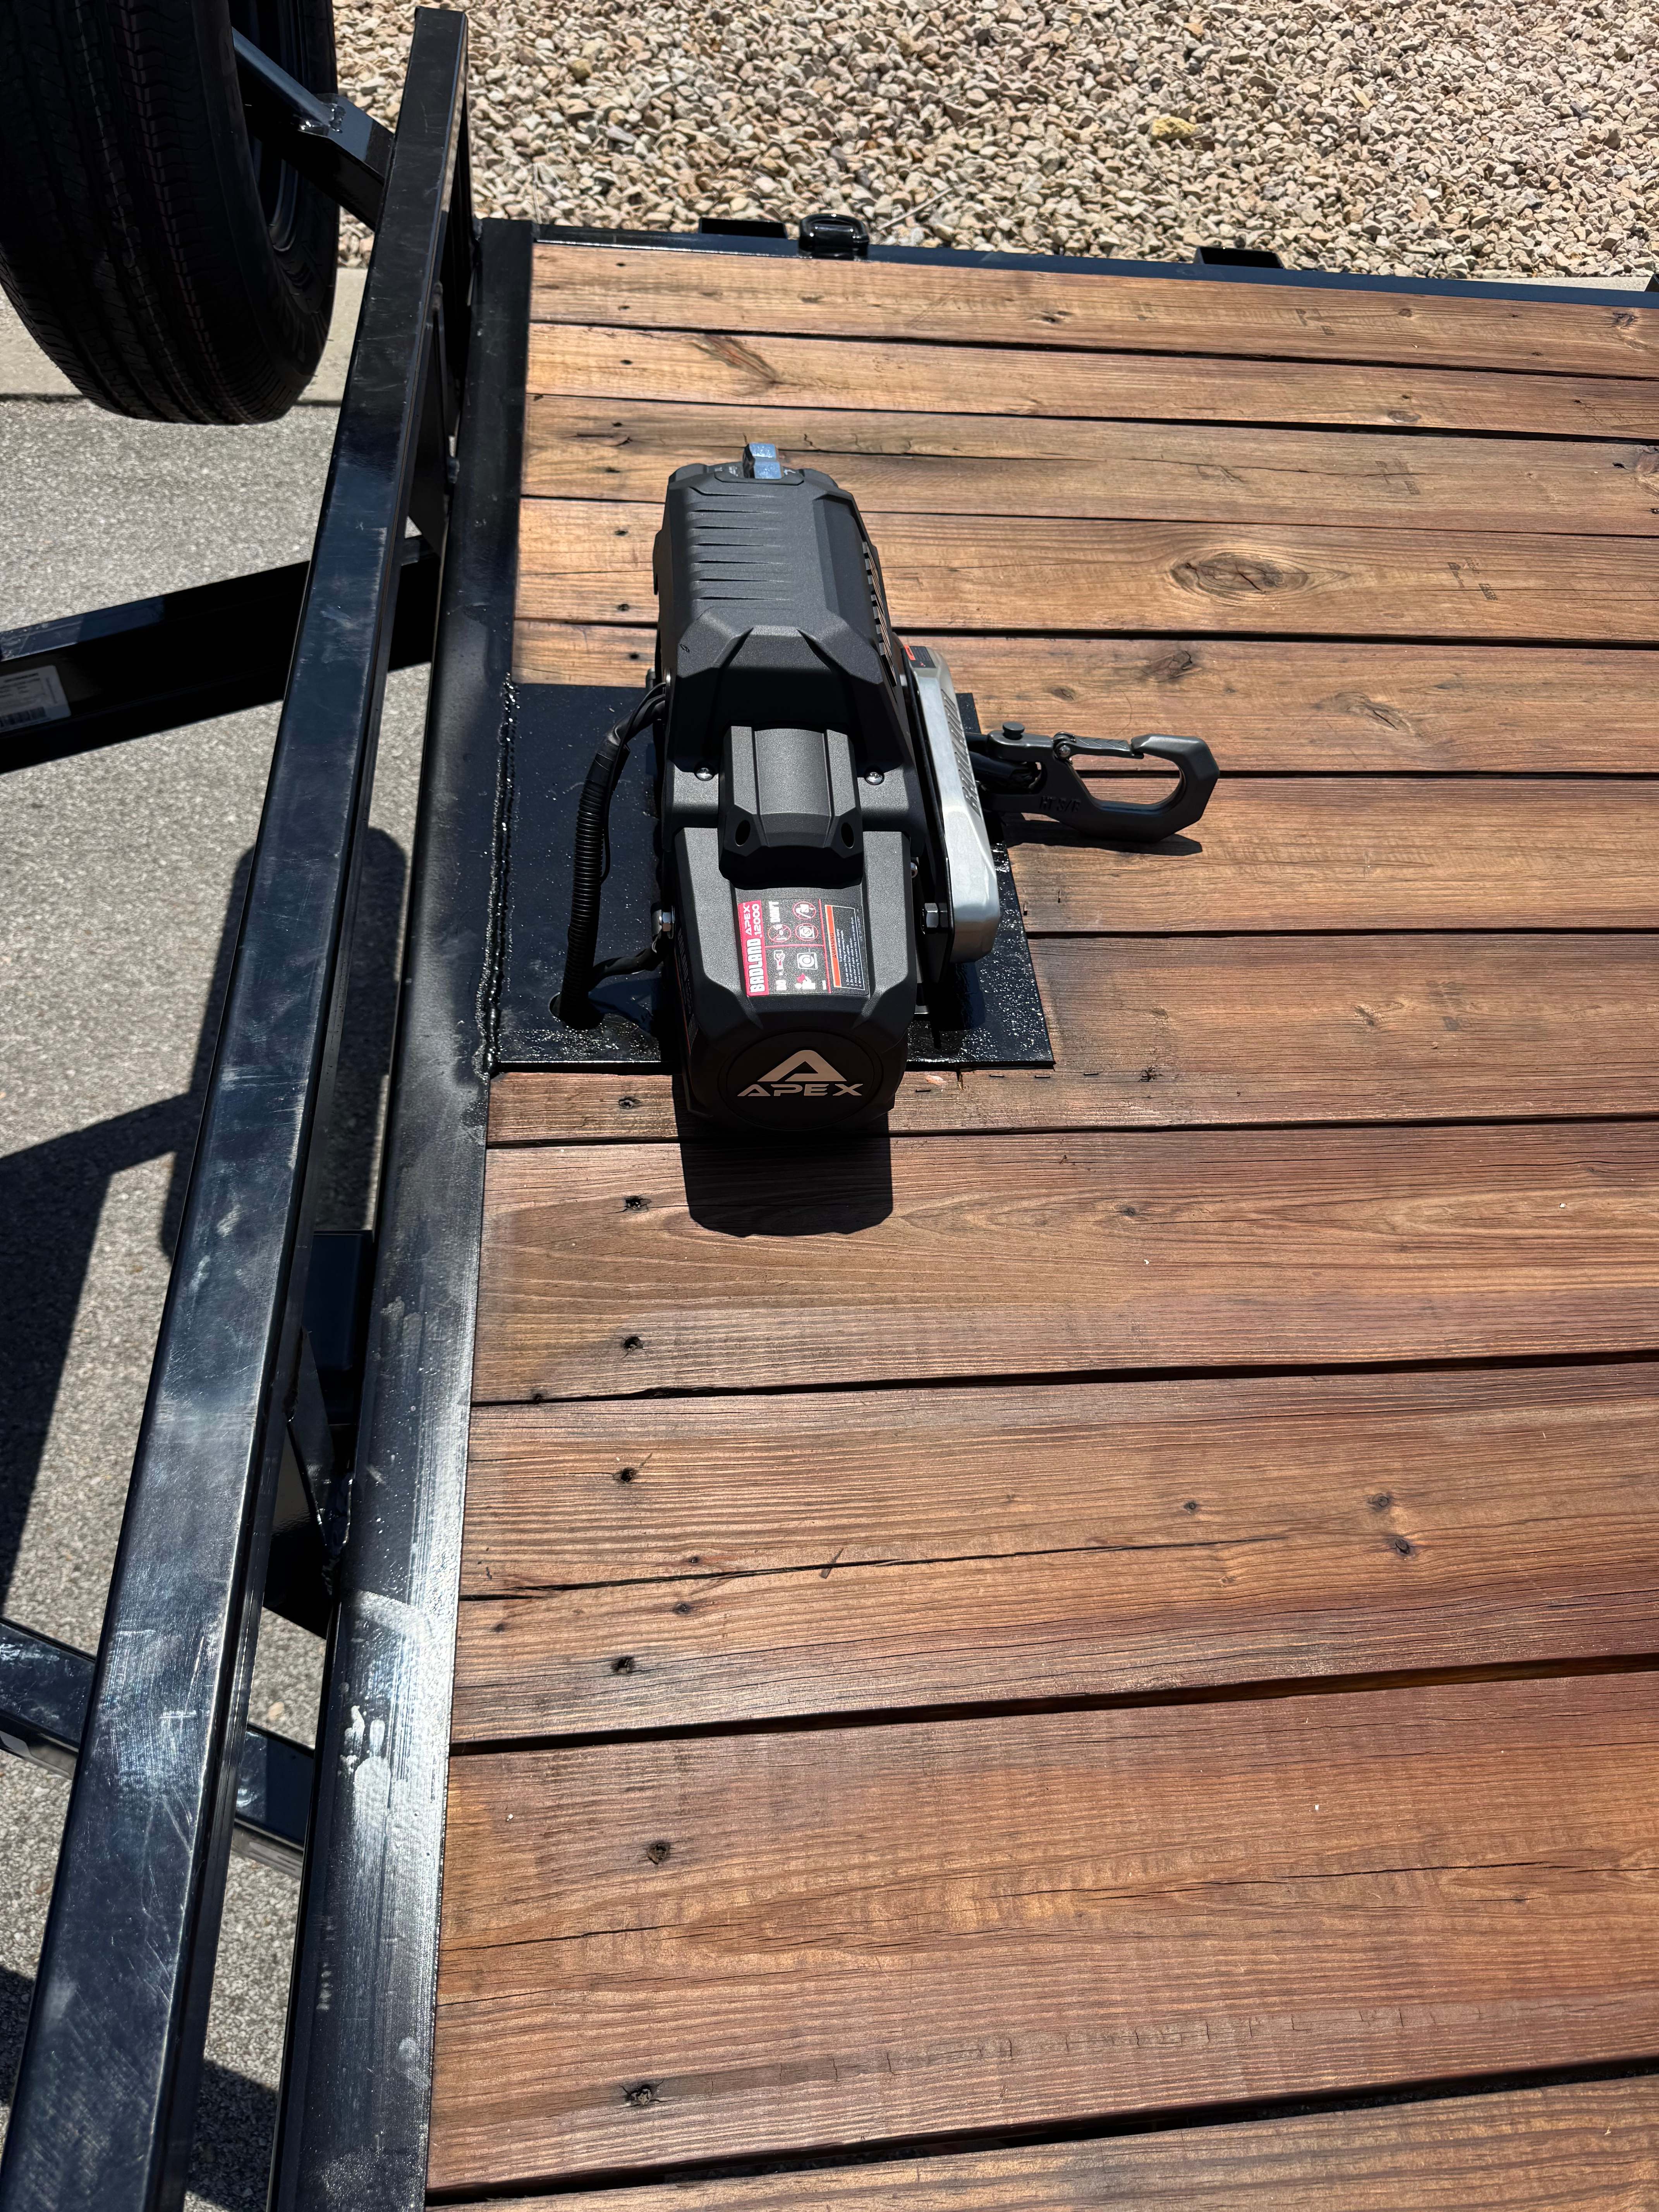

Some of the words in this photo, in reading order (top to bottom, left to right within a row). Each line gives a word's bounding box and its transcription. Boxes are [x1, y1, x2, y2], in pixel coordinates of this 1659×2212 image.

[743, 905, 752, 936] APEX
[752, 904, 762, 936] 12000
[746, 938, 765, 993] BADLAND
[776, 980, 787, 991] DO
[737, 1083, 864, 1097] APEX
